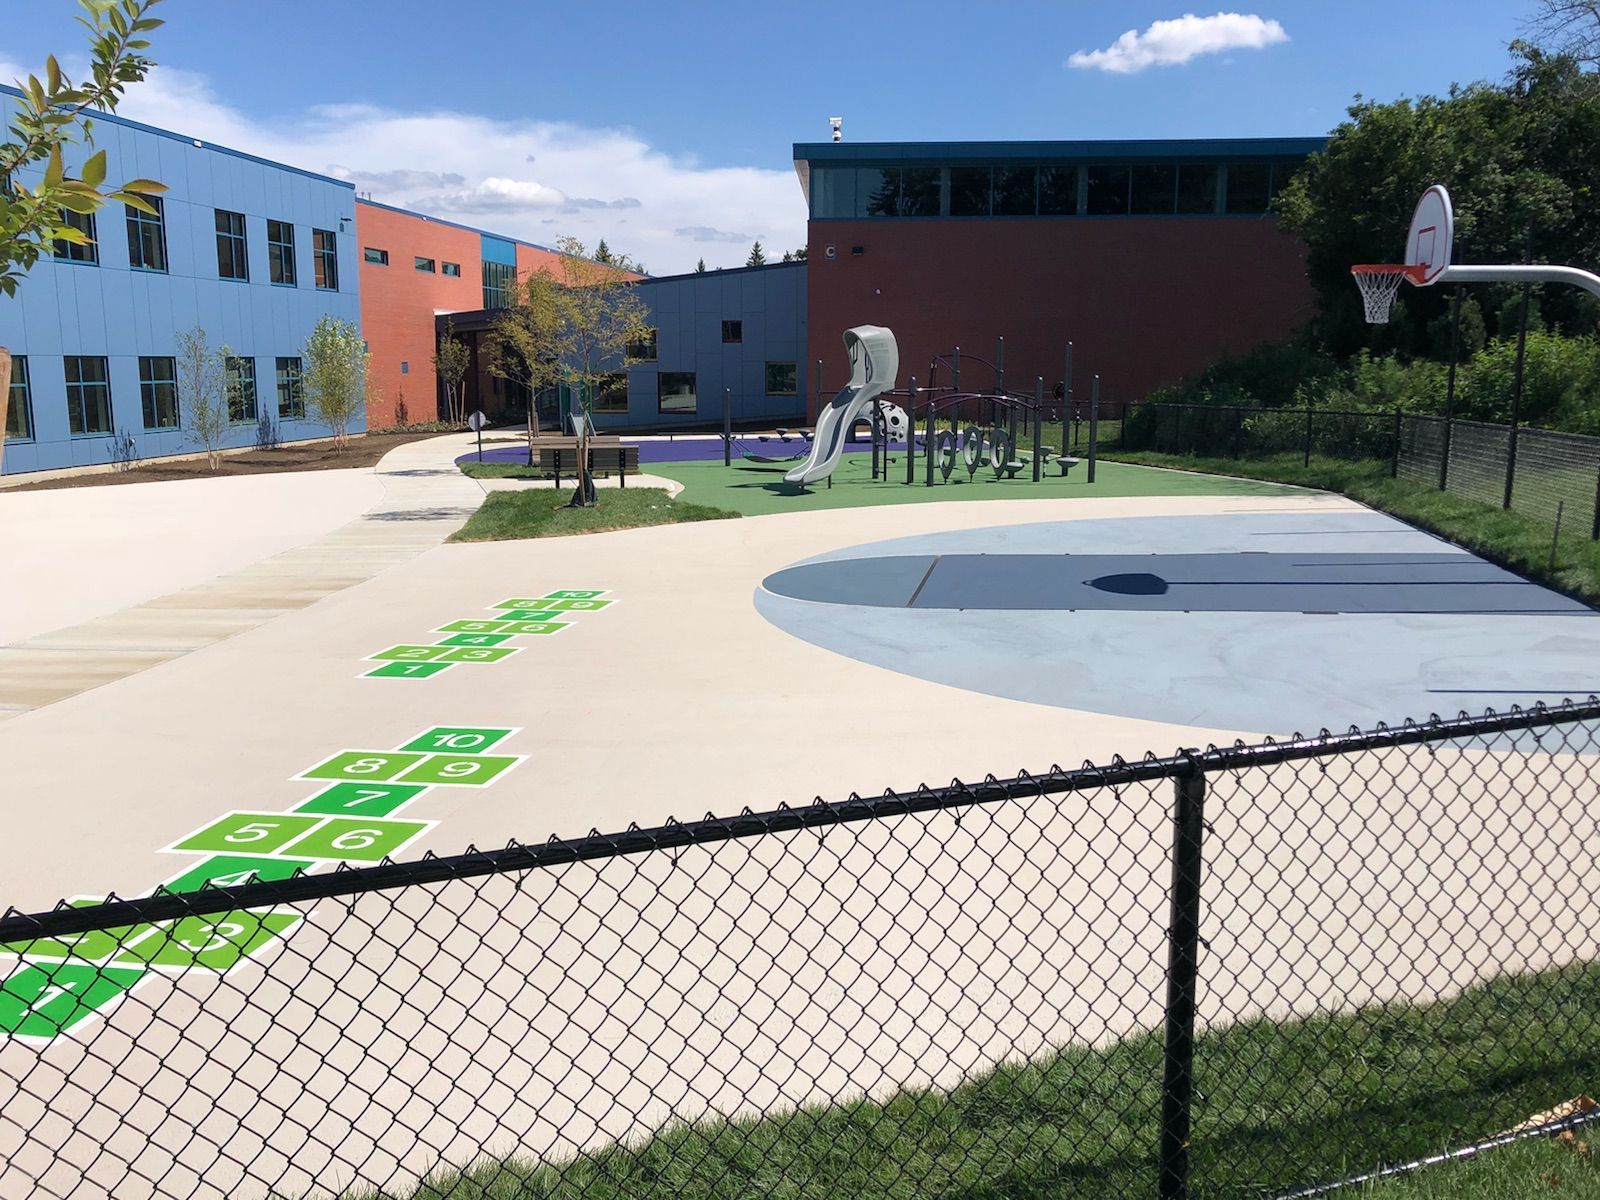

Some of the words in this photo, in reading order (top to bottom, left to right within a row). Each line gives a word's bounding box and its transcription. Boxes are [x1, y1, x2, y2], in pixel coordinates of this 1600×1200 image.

[462, 636, 490, 644] 4
[396, 649, 430, 657] 2
[462, 650, 492, 659] 3
[403, 665, 423, 674] 1
[432, 733, 485, 748] 10
[343, 758, 388, 773] 8
[437, 761, 481, 777] 9
[342, 789, 391, 807] 7
[224, 822, 280, 842] 5
[330, 829, 383, 849] 6
[177, 922, 244, 951] 3
[19, 981, 77, 1017] 1
